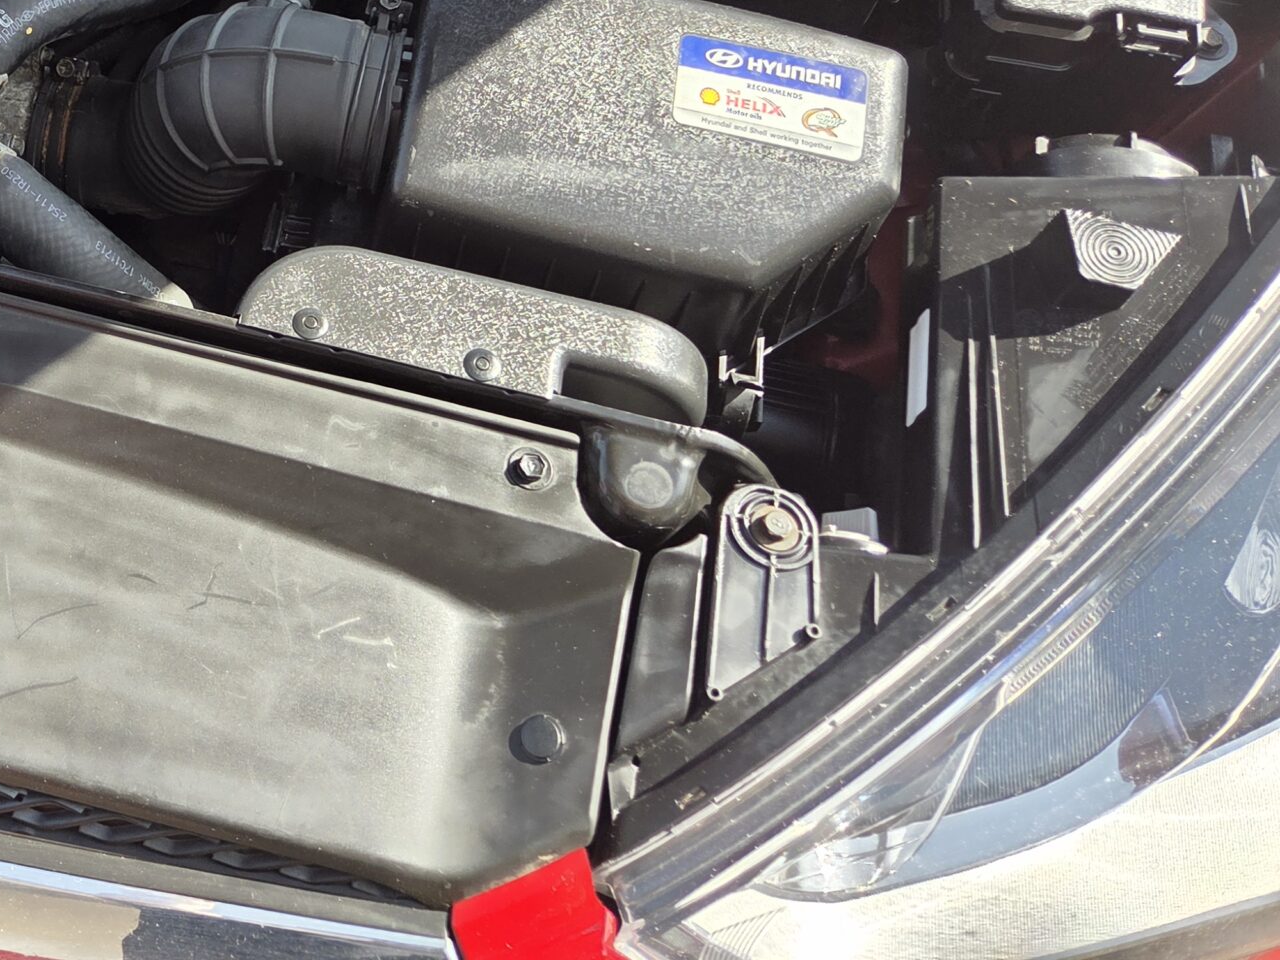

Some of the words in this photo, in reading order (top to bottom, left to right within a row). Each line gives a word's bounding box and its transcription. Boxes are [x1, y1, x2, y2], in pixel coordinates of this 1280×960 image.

[747, 56, 842, 90] HYUNDAI
[746, 82, 804, 100] RECOMMENDS
[725, 95, 784, 118] HELIX
[700, 116, 732, 129] Hyundai
[733, 123, 748, 133] and
[749, 126, 768, 137] Shell
[769, 131, 799, 145] working
[800, 138, 833, 151] together
